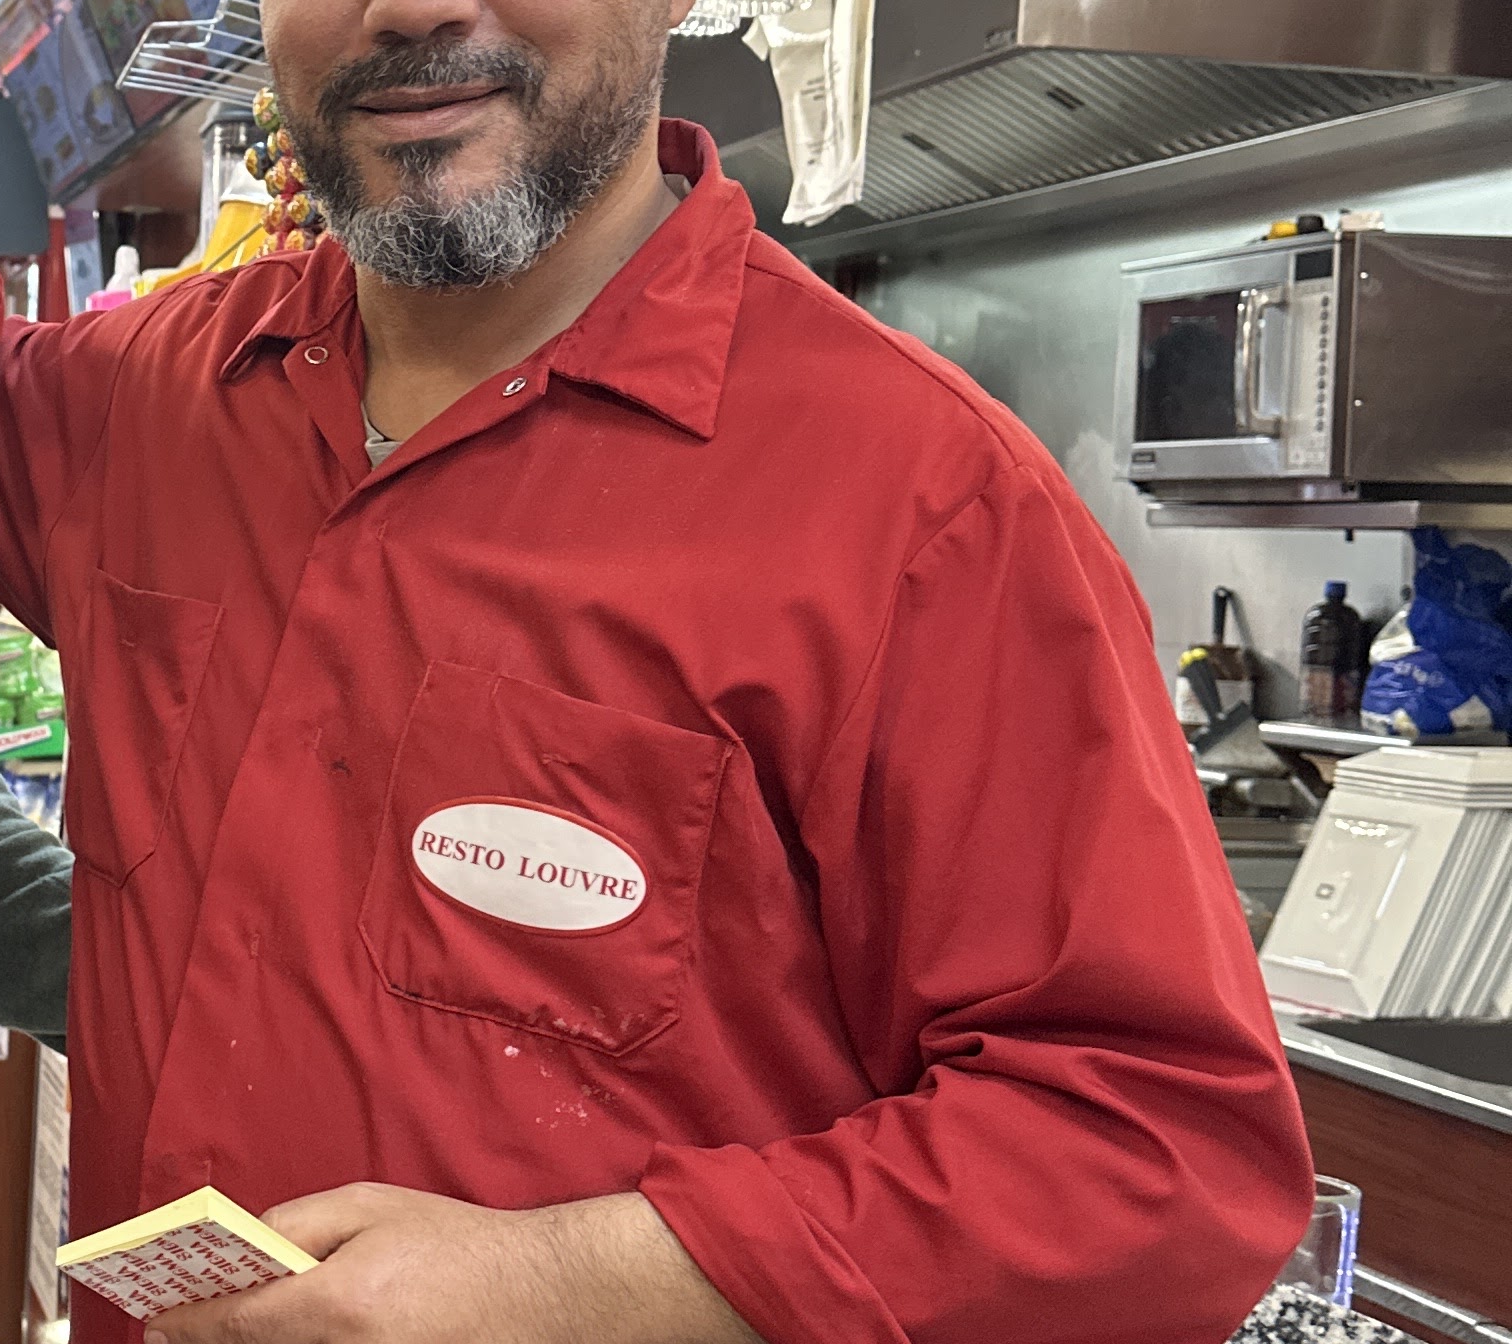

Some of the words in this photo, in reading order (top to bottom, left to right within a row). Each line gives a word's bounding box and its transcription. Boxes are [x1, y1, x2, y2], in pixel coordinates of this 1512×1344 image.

[418, 831, 505, 871] RESTO
[517, 856, 638, 901] LOUVRE
[188, 1224, 229, 1247] SIGM
[122, 1253, 155, 1271] SIGM
[153, 1238, 191, 1260] SIGM
[191, 1241, 241, 1275] SIGMA
[84, 1262, 119, 1281] SIGM
[155, 1252, 205, 1285] SIGMA
[200, 1267, 242, 1294] IGMA
[238, 1254, 278, 1281] IGMA
[130, 1290, 169, 1313] IGMA
[164, 1277, 205, 1303] IGMA
